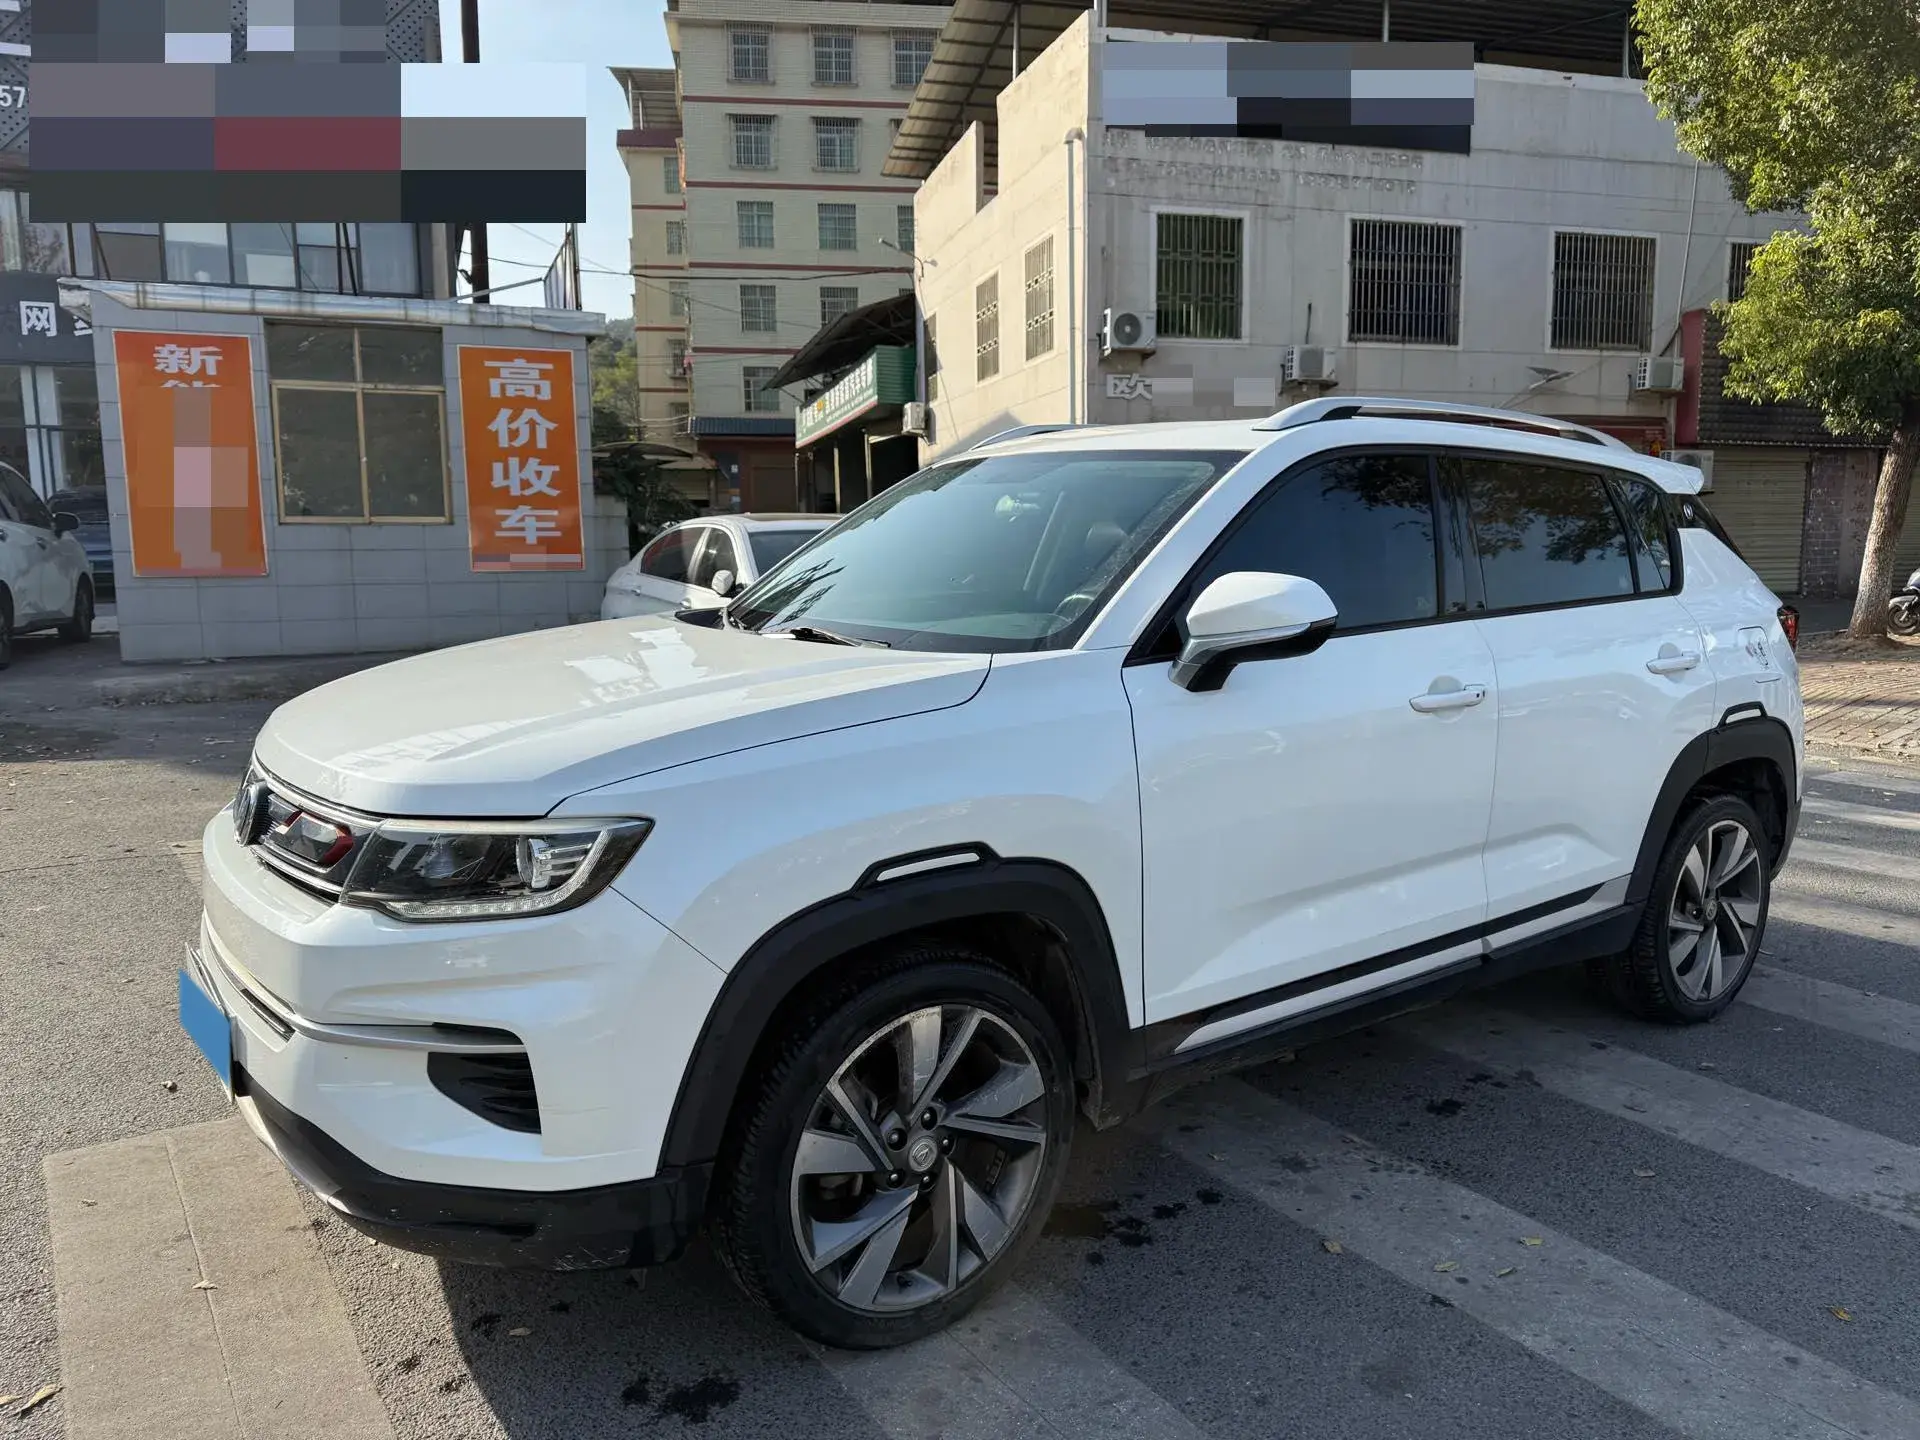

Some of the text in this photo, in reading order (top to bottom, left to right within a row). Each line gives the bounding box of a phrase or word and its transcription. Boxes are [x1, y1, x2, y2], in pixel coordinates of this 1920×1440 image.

[153, 343, 224, 387] 新
[1106, 372, 1152, 400] 欧
[484, 358, 562, 545] 高价收车
